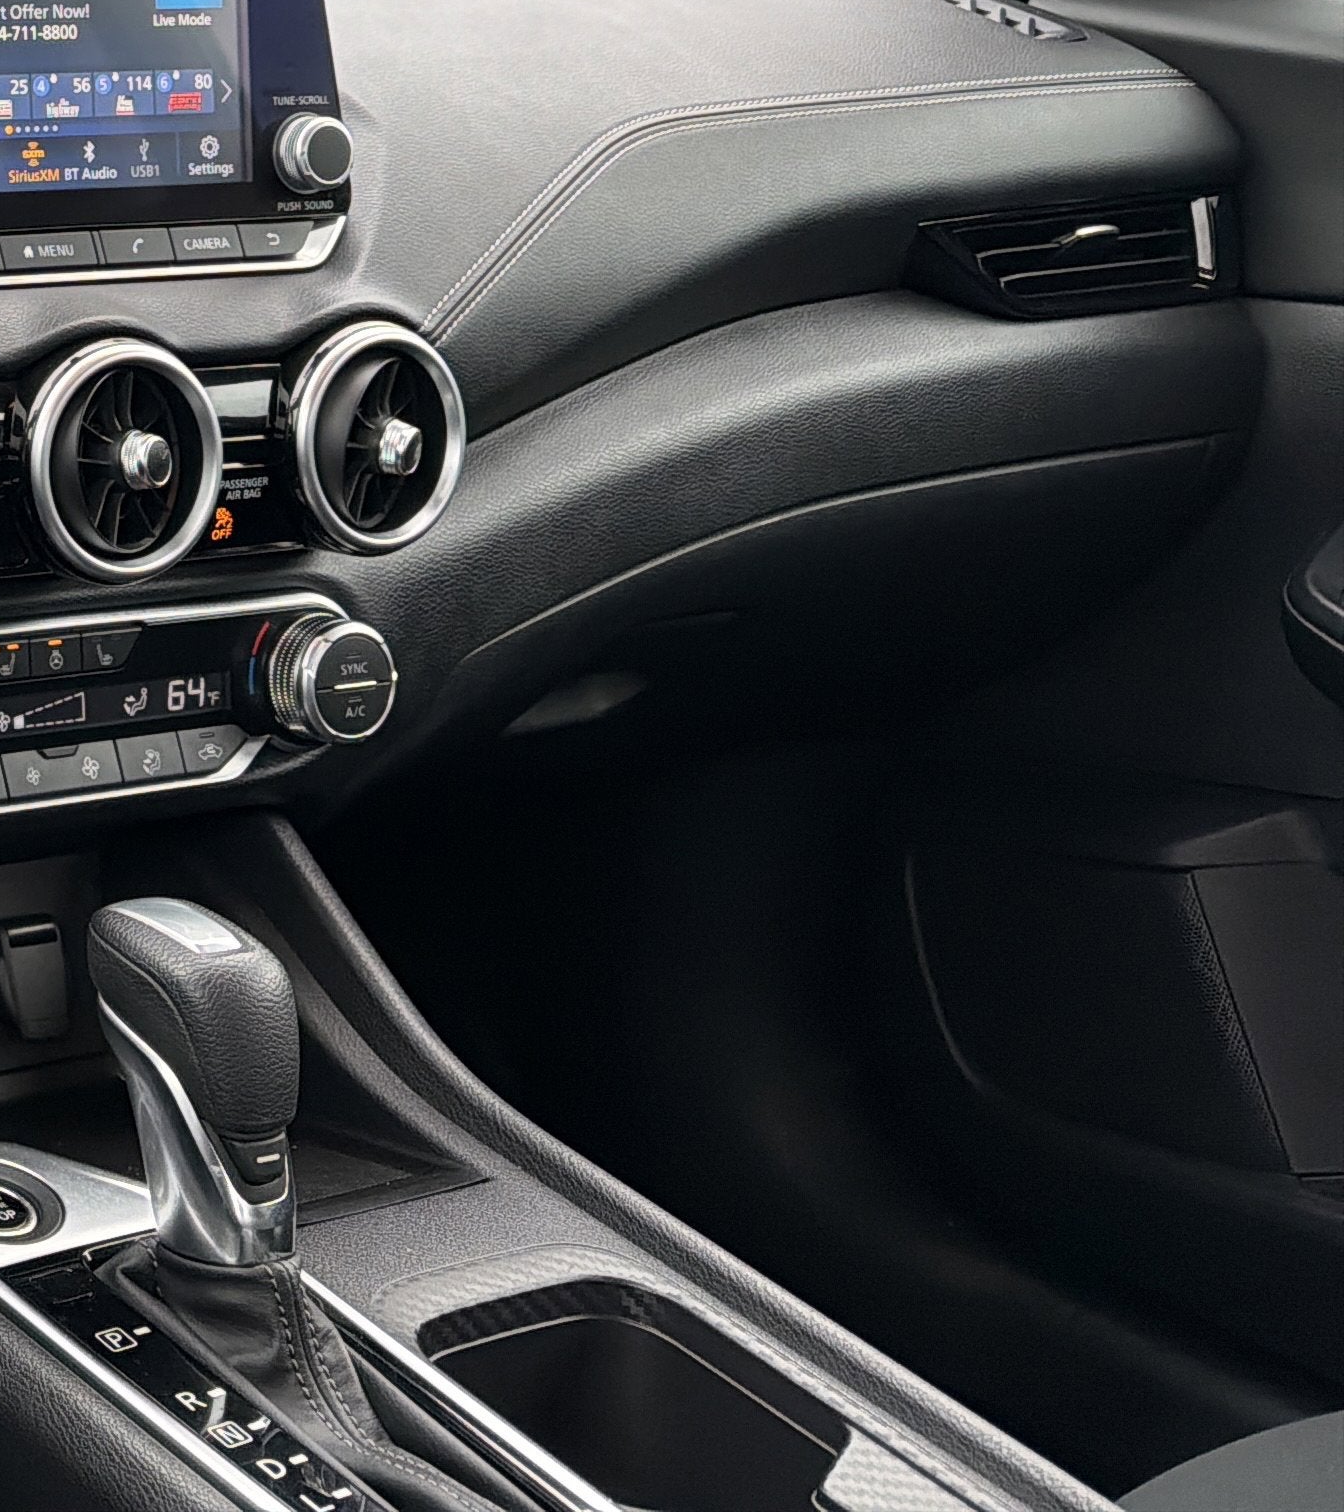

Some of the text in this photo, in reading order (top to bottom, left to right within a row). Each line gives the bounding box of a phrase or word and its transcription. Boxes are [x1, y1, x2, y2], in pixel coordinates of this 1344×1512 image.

[10, 4, 49, 20] Offer
[52, 3, 90, 20] Now!
[152, 13, 212, 28] Live Mode
[10, 79, 29, 95] 25
[73, 77, 91, 94] 56
[126, 75, 153, 92] 114
[194, 73, 213, 90] 80
[8, 168, 60, 184] SiriusXM
[64, 164, 118, 181] BT Audio
[130, 162, 161, 178] USB1
[188, 160, 234, 178] Settings
[277, 199, 334, 212] PUSH SOUND
[38, 244, 75, 258] MENU
[183, 236, 230, 251] CAMERA
[219, 476, 269, 490] PASSENGER
[226, 488, 261, 500] AIR BAG
[212, 529, 232, 541] OFF
[340, 662, 368, 676] SYNC
[345, 703, 366, 719] A/C
[175, 1391, 209, 1413] R
[256, 1458, 288, 1480] D
